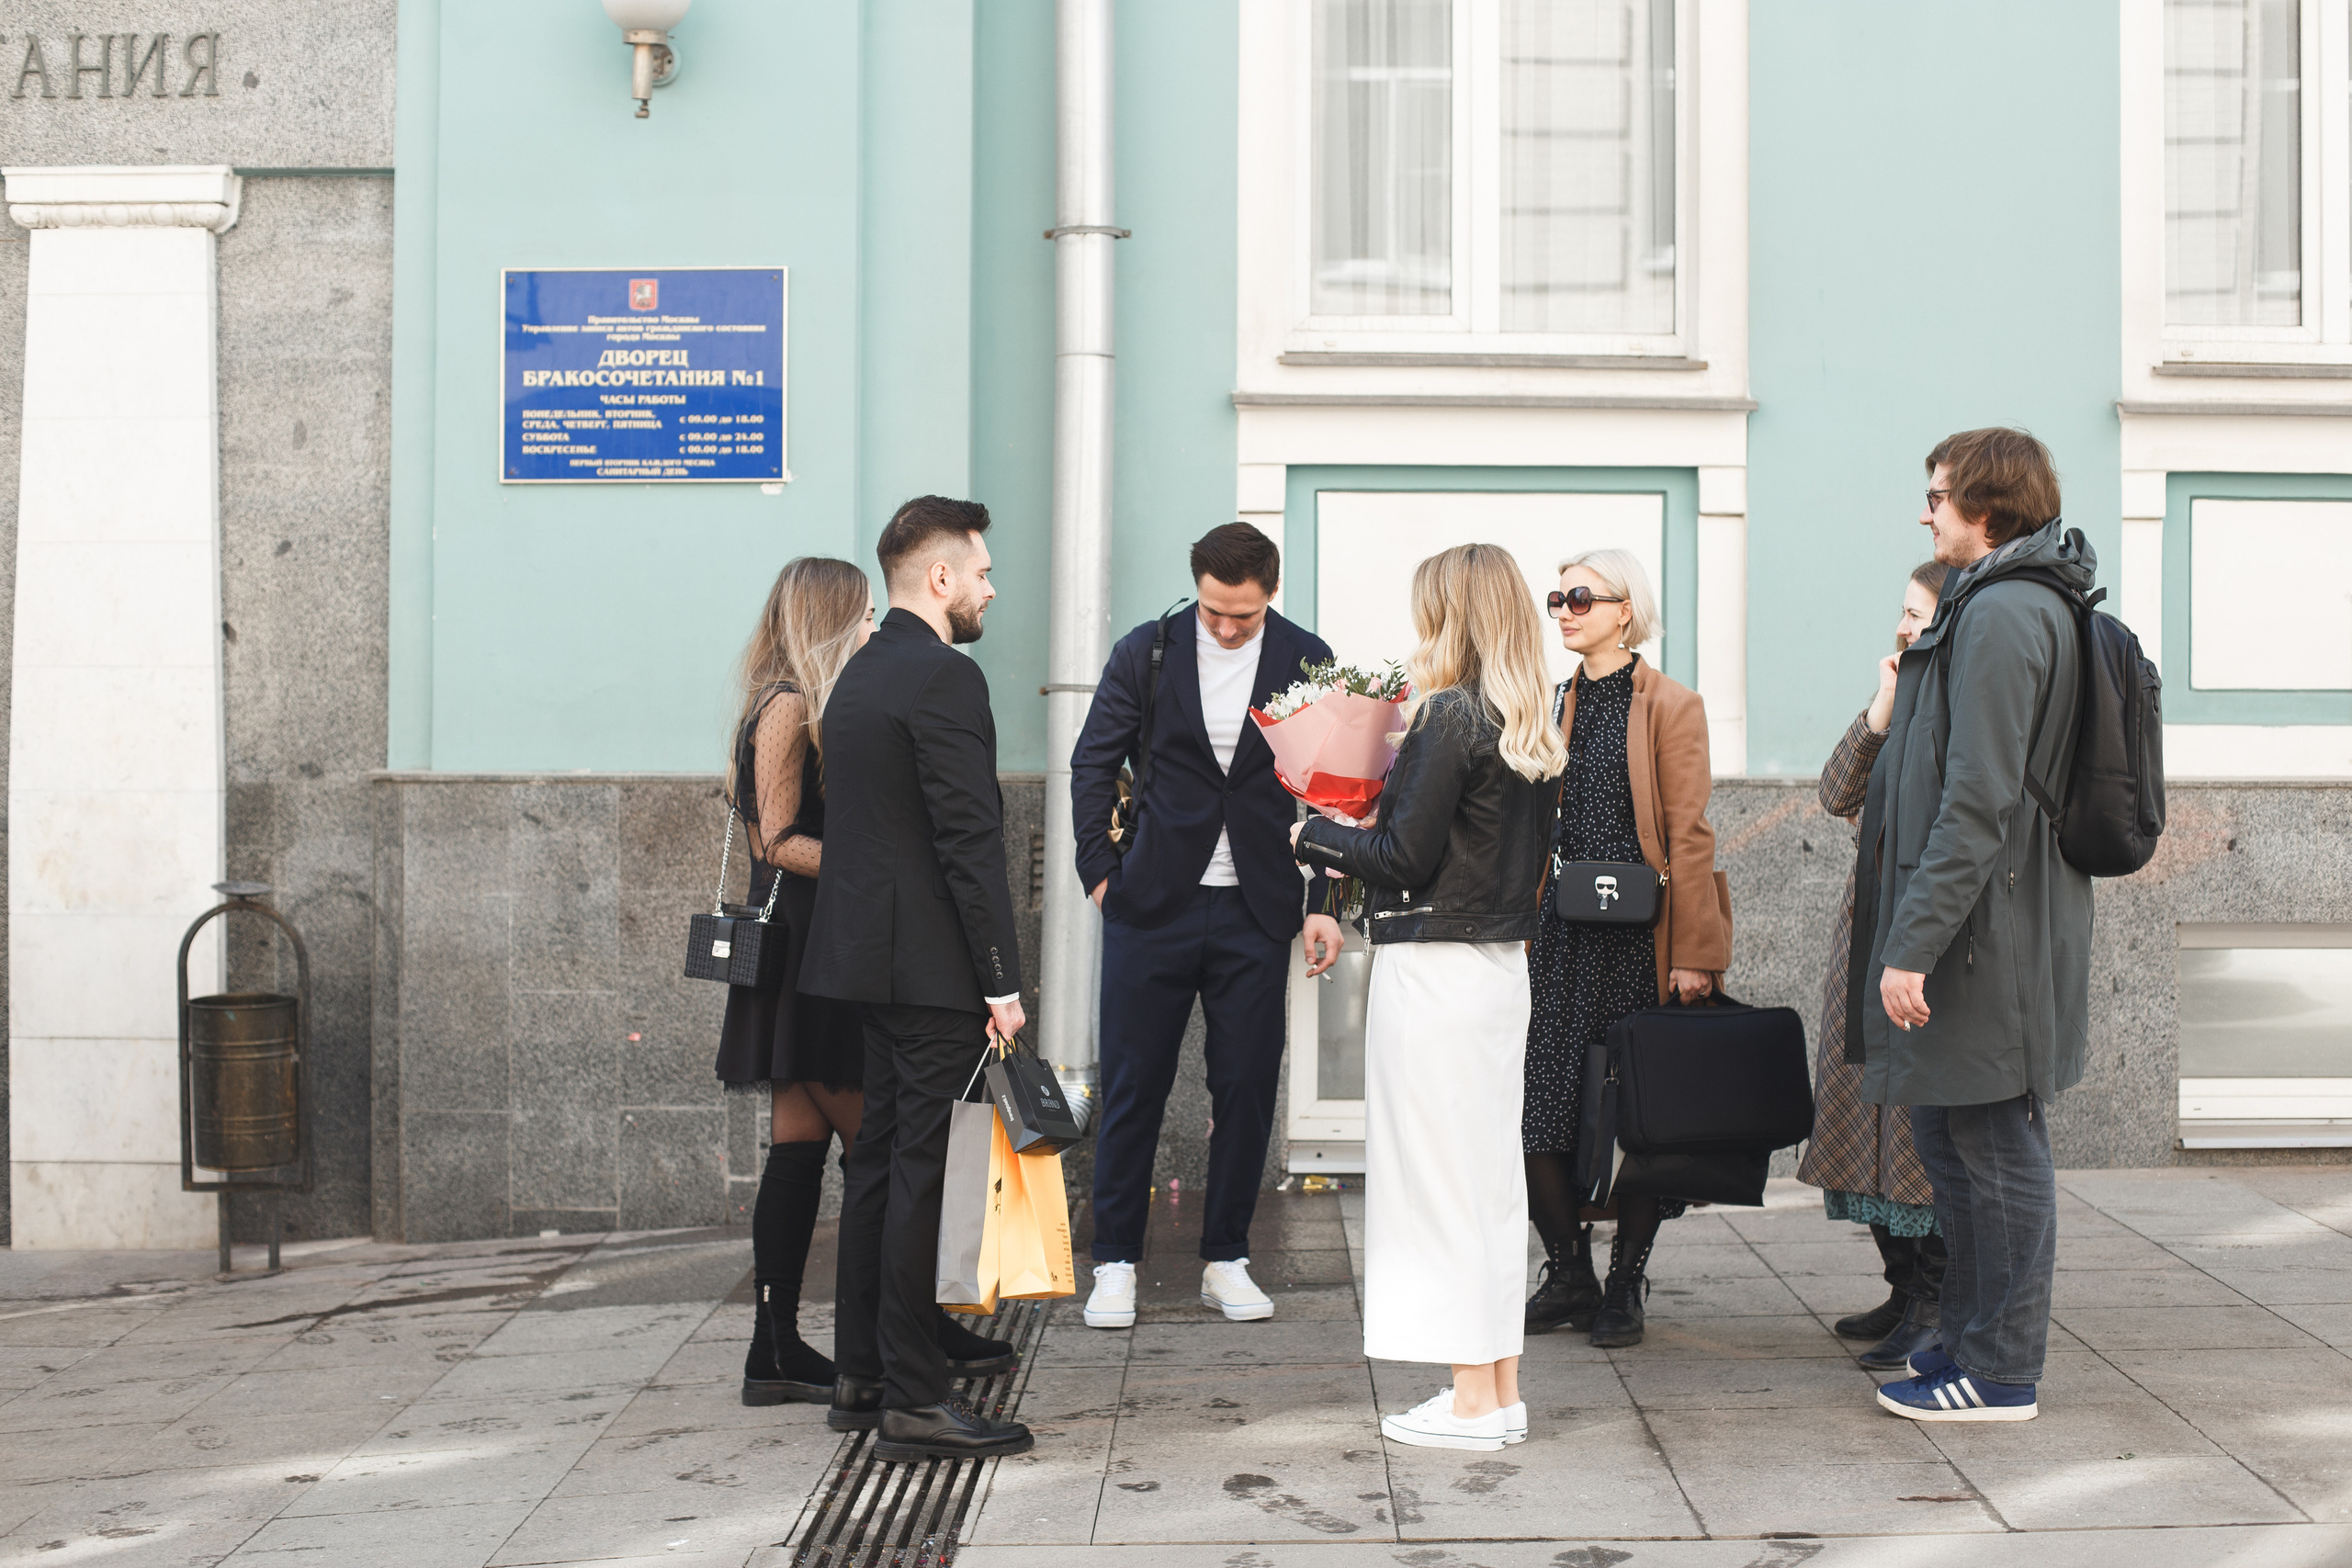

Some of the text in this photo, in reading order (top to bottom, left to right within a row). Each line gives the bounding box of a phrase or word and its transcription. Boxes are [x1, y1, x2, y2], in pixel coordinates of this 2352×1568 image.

[0, 31, 220, 98] АНИЯ
[606, 333, 641, 343] города
[597, 350, 690, 368] ДВОРЕЦ
[522, 370, 765, 387] БРАКОСОЧЕТАНИЯ №1
[599, 394, 687, 405] ЧАСЫ РАБОТЫ
[718, 416, 733, 424] до
[735, 415, 765, 424] 18.00
[612, 420, 663, 430] ПЯТНИЦА
[522, 433, 571, 443] СУББОТА
[718, 434, 733, 442] до
[734, 433, 765, 442] 24.00
[522, 446, 597, 455] ВОСКРЕСЕНЬЕ
[718, 446, 733, 455] до
[735, 446, 765, 455] 18.00
[570, 459, 717, 468] ПЕРВЫЙ ВТОРНИК КАЖДОГО МЕСЯЦА
[596, 468, 690, 477] САНИТАРНЫЙ ДЕНЬ
